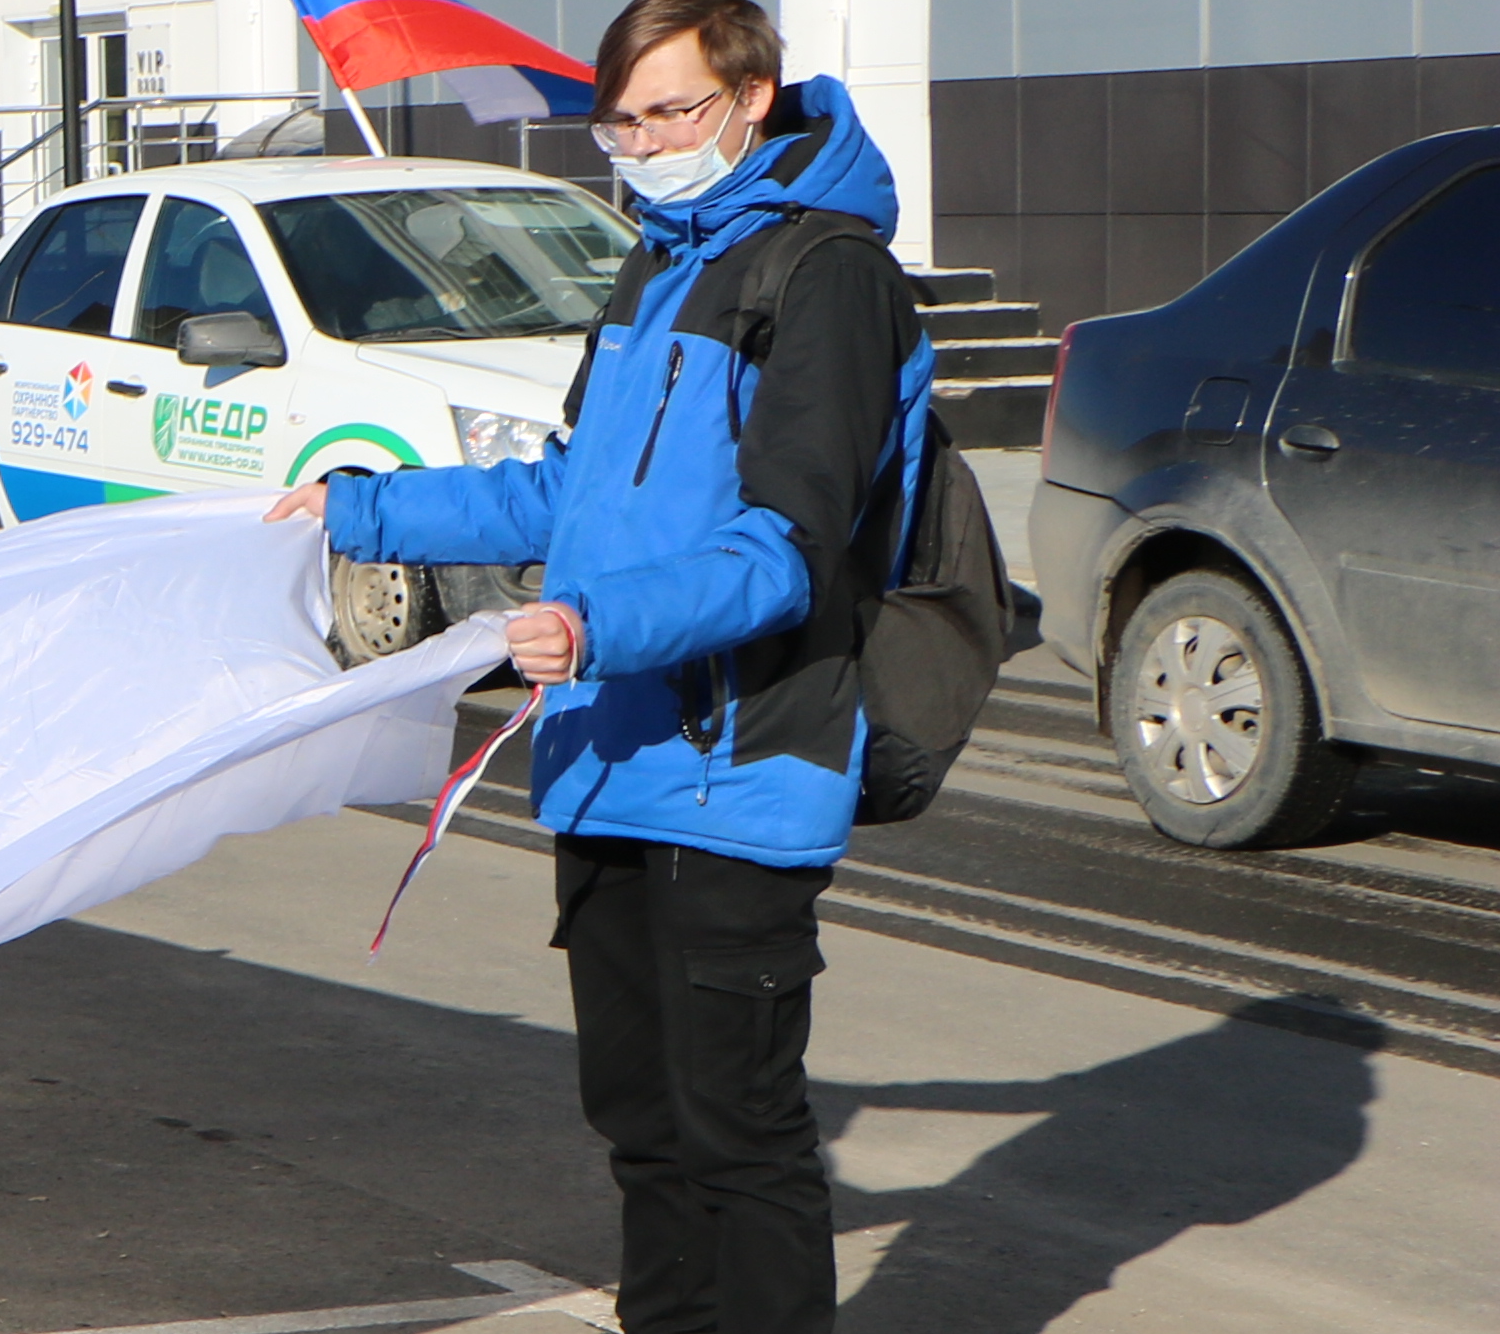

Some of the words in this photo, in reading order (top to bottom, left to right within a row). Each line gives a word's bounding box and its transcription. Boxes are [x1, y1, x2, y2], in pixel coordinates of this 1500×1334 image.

[136, 49, 164, 75] VIP
[137, 76, 165, 94] ВХОД
[13, 390, 60, 408] ОХРАННОЕ
[179, 396, 268, 441] КЕДР
[11, 420, 89, 454] 929-474
